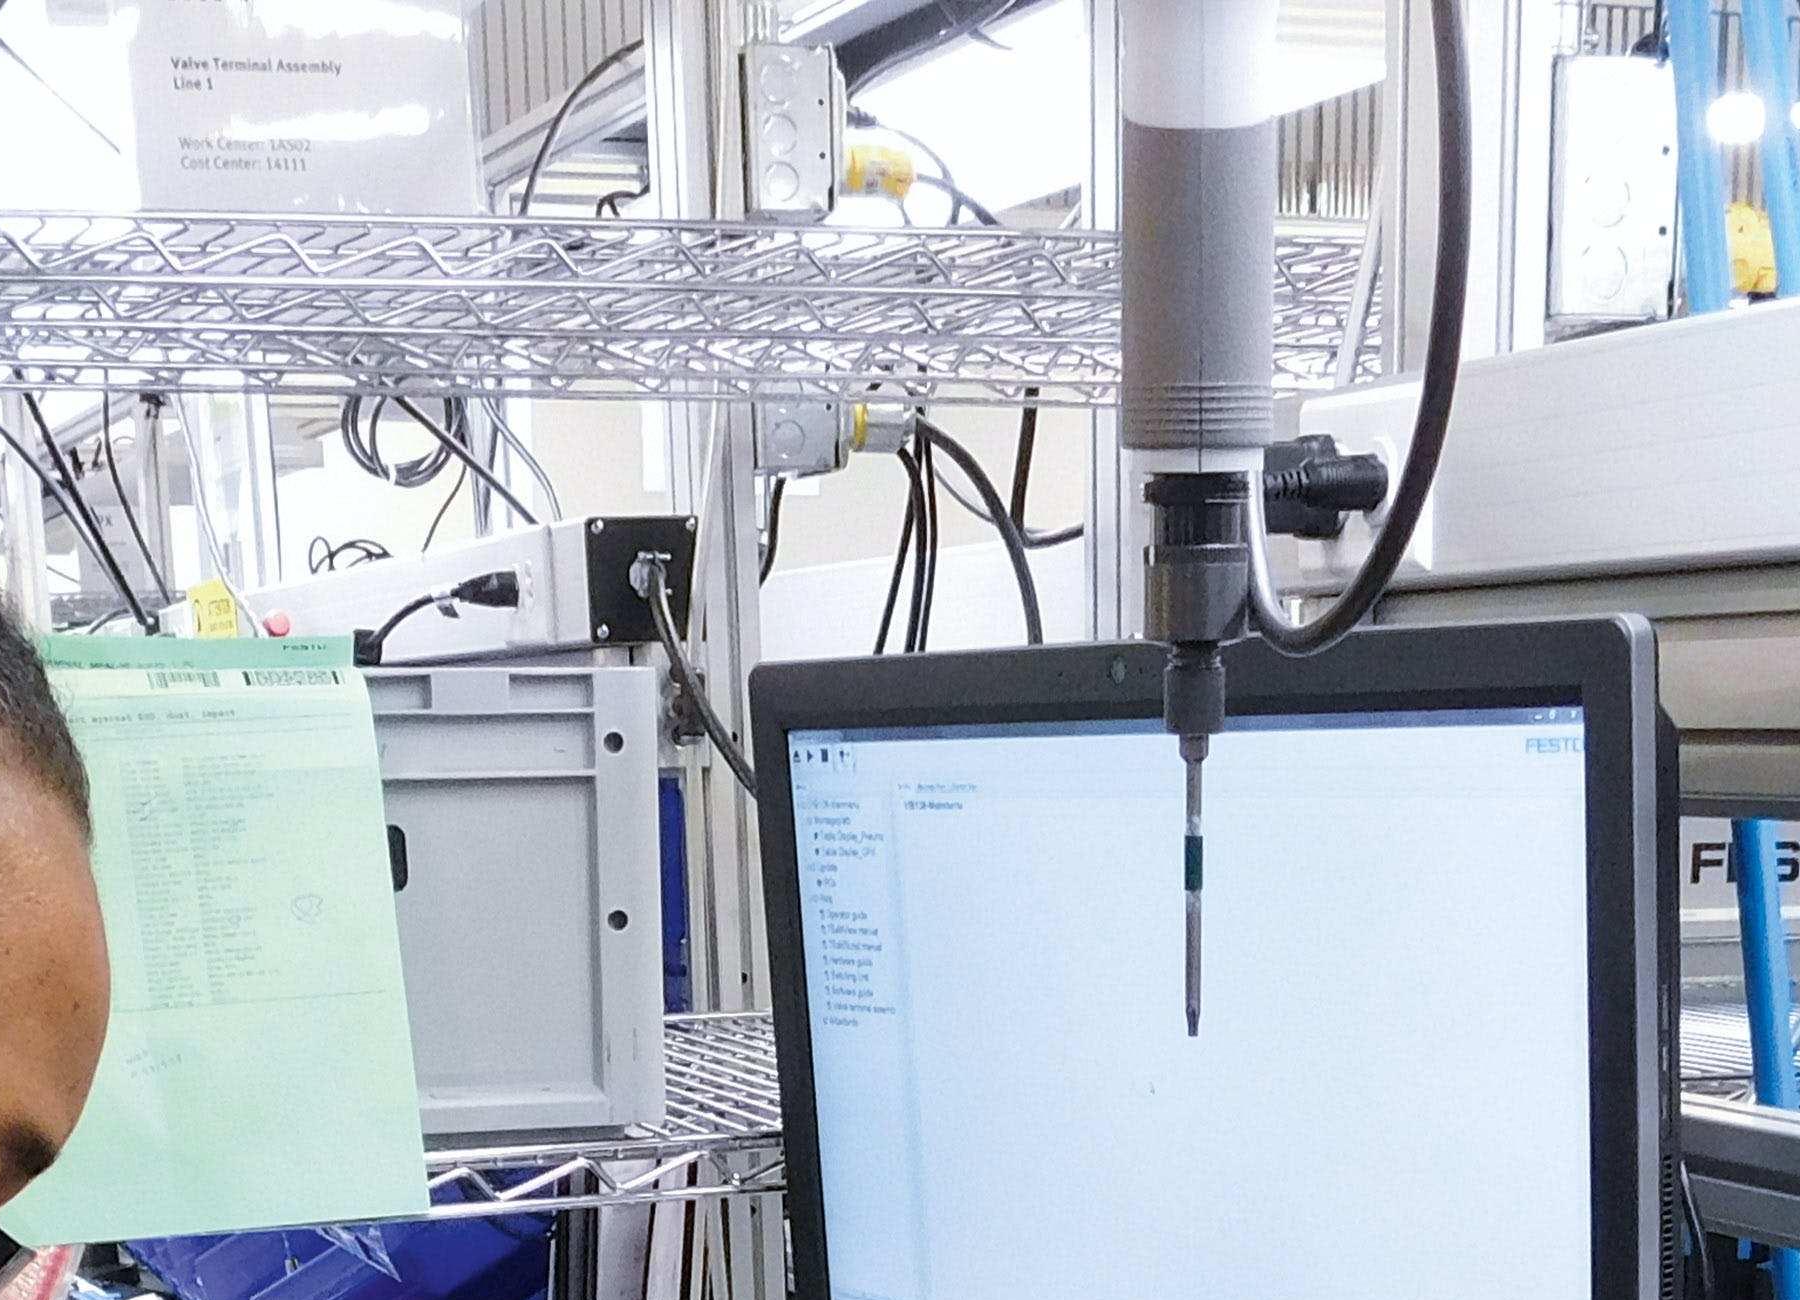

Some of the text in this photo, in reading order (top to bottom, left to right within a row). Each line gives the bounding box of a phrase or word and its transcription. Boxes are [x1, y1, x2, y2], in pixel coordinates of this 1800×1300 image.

[171, 56, 342, 77] Valve Terminal Assembly
[174, 78, 214, 90] Line 1
[178, 136, 213, 150] Work
[180, 157, 210, 171] Cost
[266, 157, 308, 172] 14111
